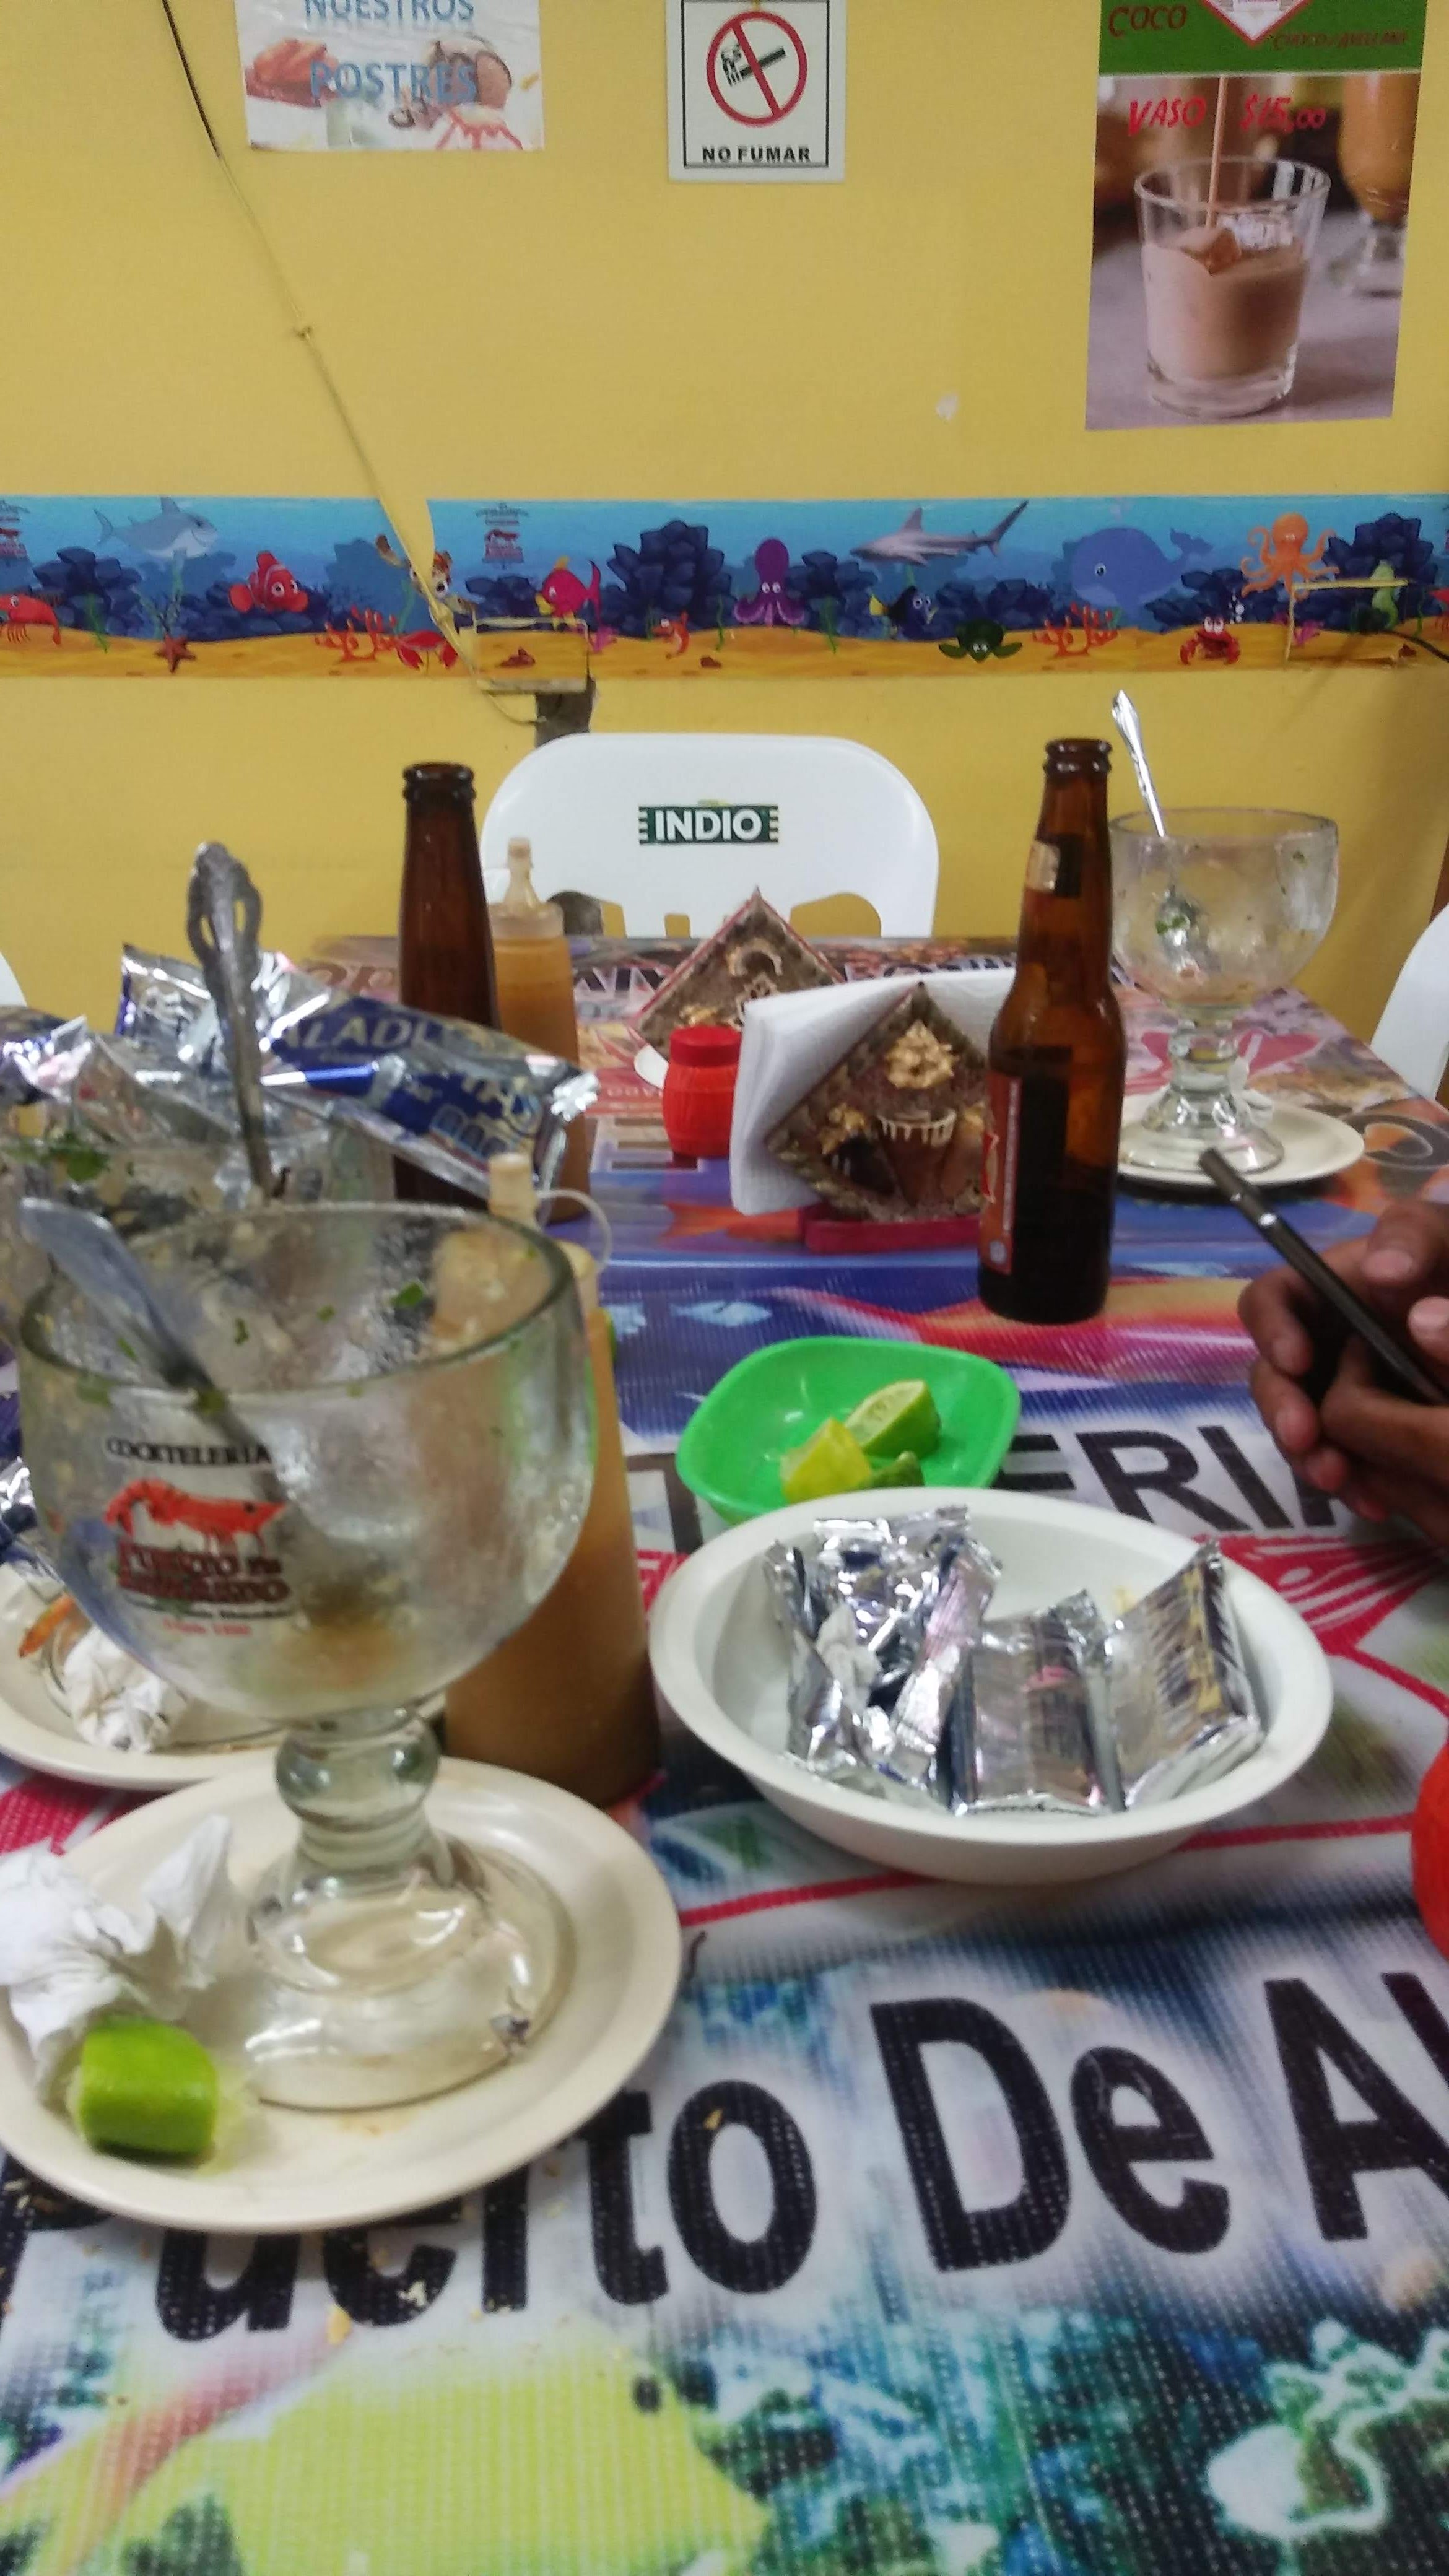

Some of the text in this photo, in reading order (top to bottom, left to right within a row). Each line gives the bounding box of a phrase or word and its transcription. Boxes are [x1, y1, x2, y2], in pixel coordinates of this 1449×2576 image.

[1108, 5, 1187, 38] COCO
[311, 61, 477, 104] POSTRES
[1128, 97, 1207, 136] VASO
[702, 147, 811, 163] NO FUMAR
[655, 808, 762, 842] INDIO
[870, 1996, 1231, 2273] De
